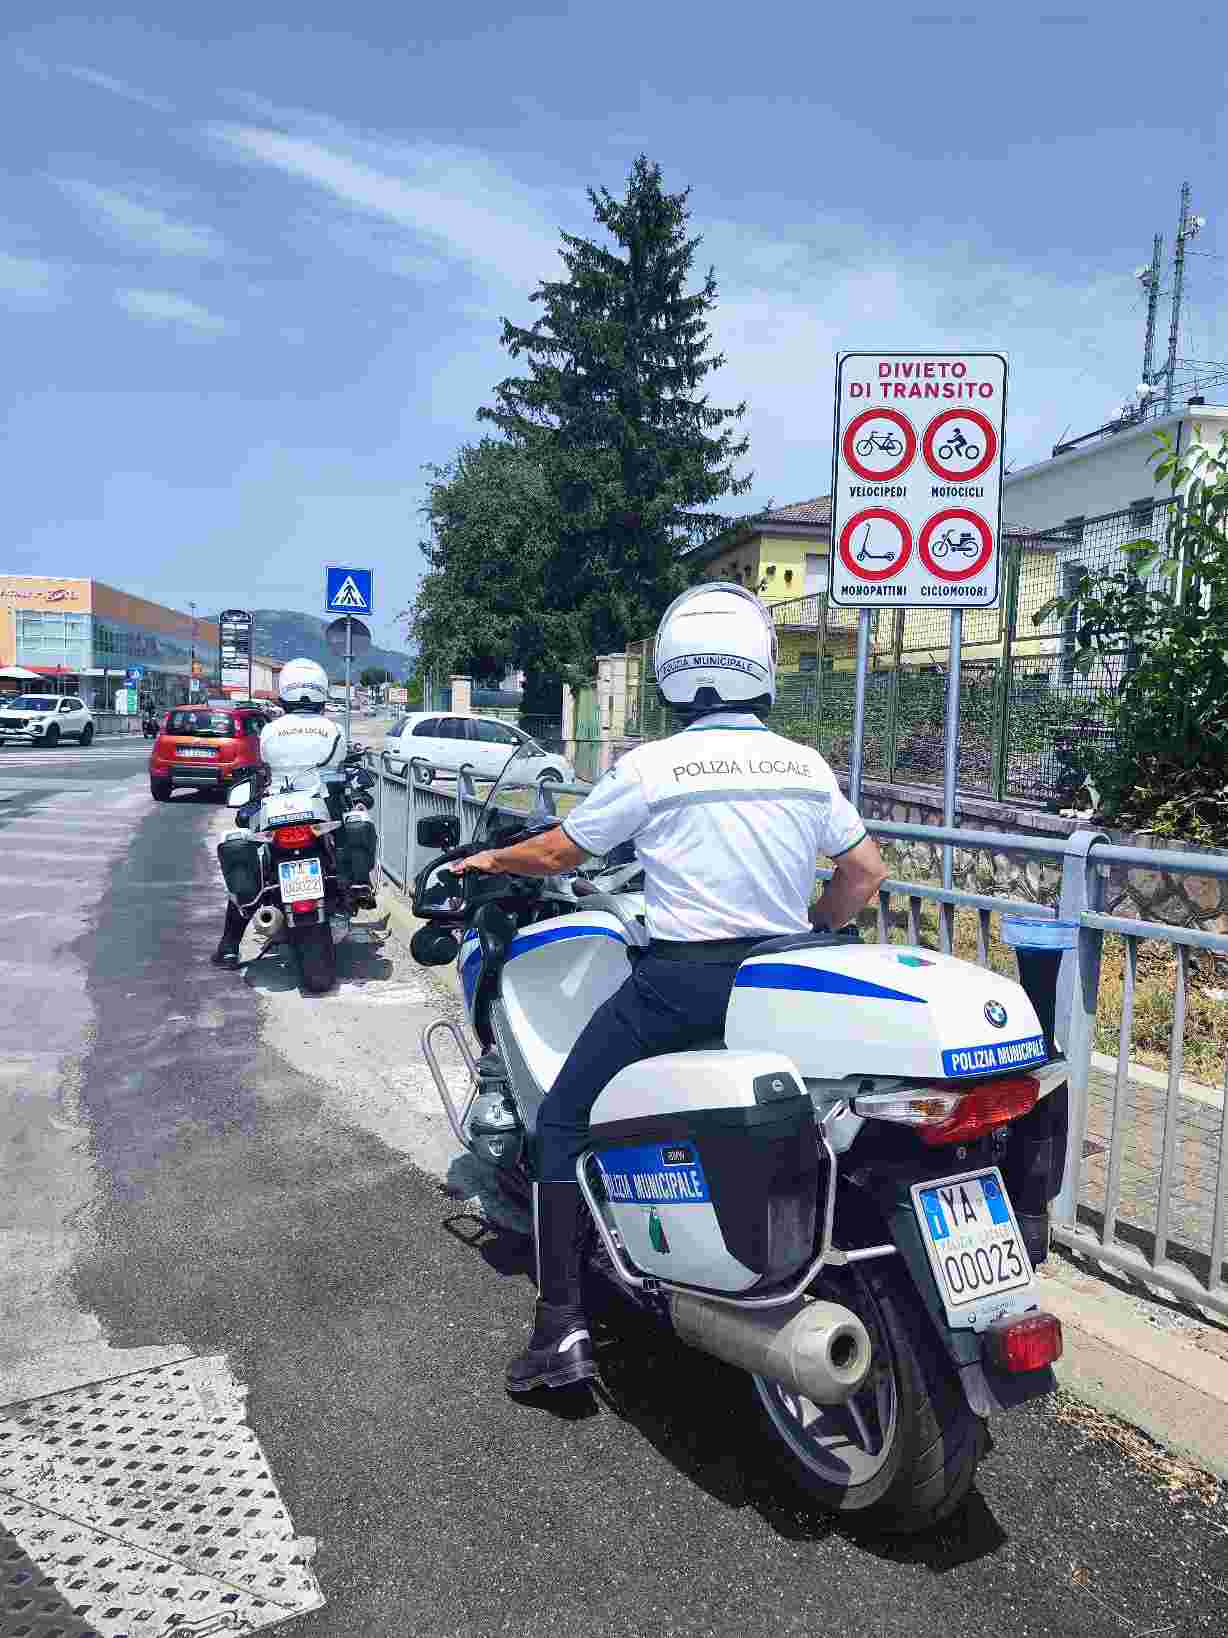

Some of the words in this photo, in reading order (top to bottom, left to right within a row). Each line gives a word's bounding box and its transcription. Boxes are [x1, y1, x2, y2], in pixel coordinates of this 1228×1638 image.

[878, 362, 967, 378] DIVIETO
[849, 383, 871, 398] DI
[880, 382, 993, 398] TRANSITO
[849, 486, 907, 498] VELOCIPEDI
[931, 486, 984, 498] MOTOCICLI
[841, 585, 907, 597] MONOPATTINI
[920, 585, 987, 597] CICLOMOTORI
[693, 655, 754, 672] MUNICIPALE
[672, 760, 743, 783] POLIZIA
[749, 760, 812, 778] LOCALE
[951, 1049, 996, 1073] POLIZIA
[998, 1038, 1046, 1066] MUNICIPALE
[633, 1170, 704, 1200] MUNICIPALE
[941, 1186, 978, 1226] YA
[945, 1239, 1023, 1293] 00023
